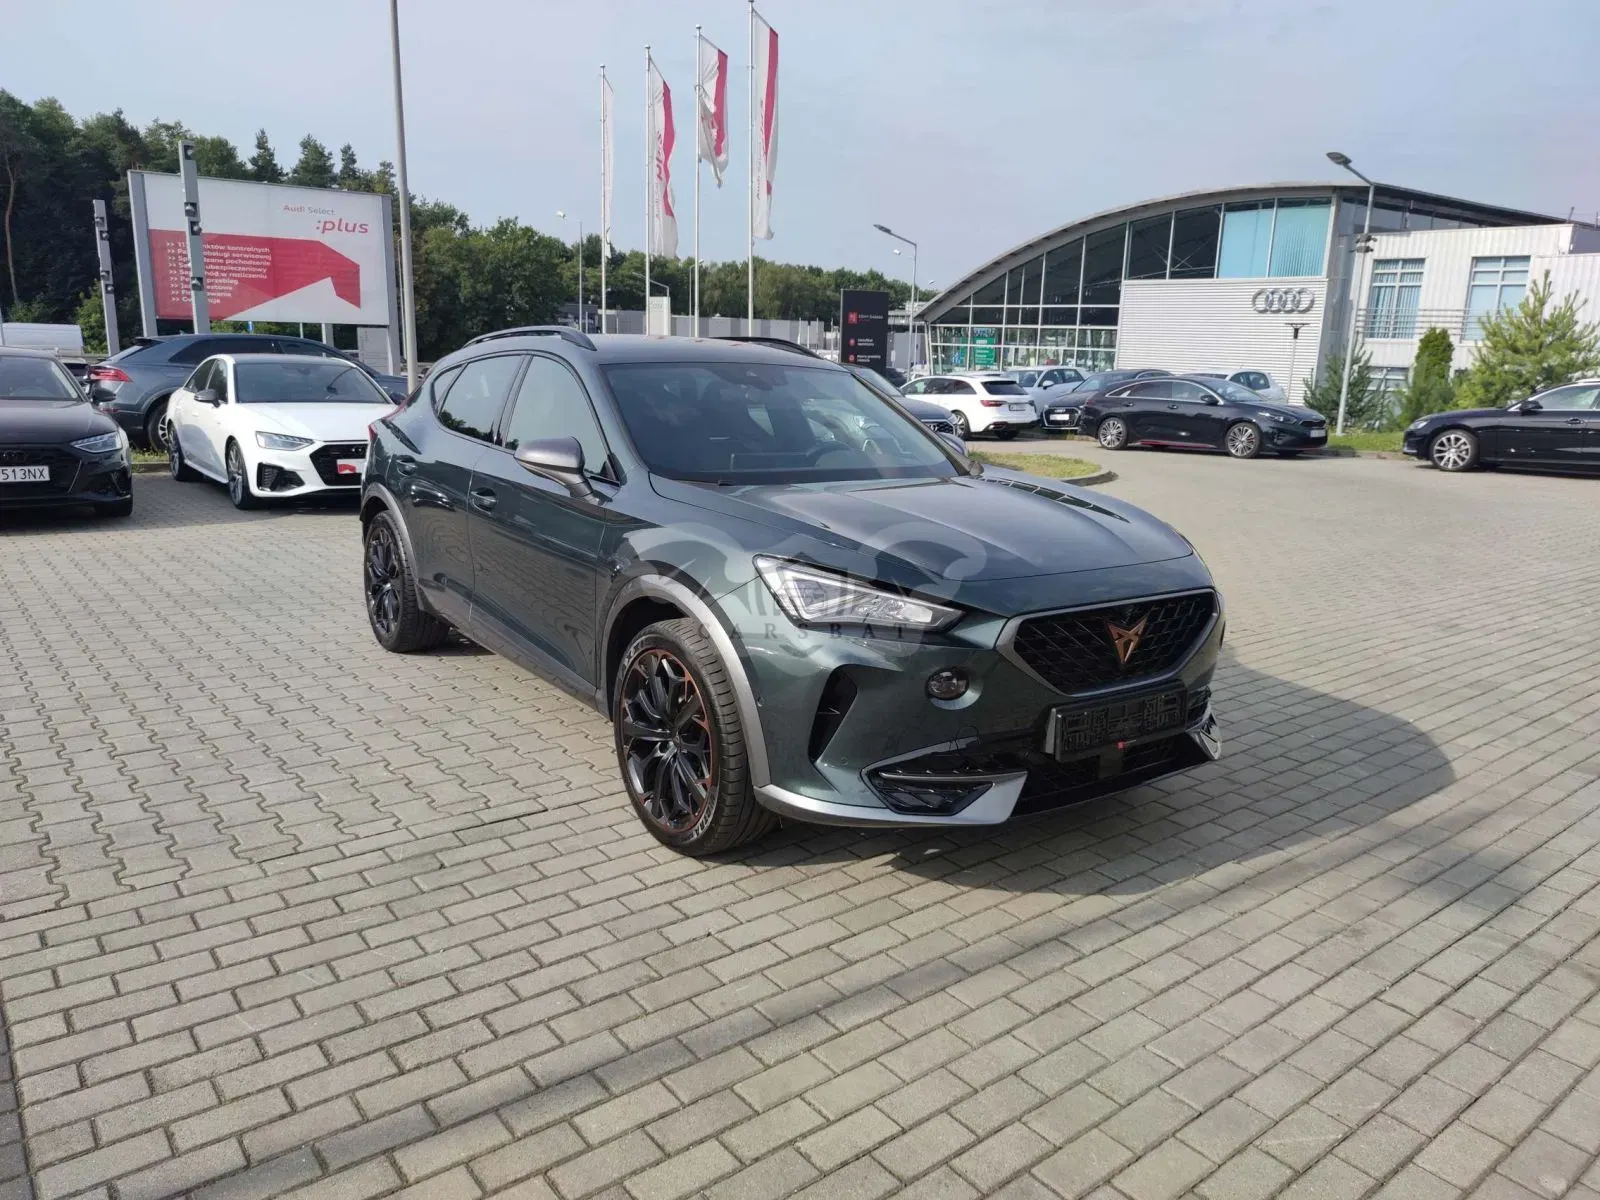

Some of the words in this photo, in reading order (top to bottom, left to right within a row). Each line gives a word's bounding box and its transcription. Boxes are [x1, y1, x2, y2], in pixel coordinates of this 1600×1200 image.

[308, 207, 335, 216] Select
[316, 218, 369, 234] :plus
[227, 245, 270, 253] kontrolnych
[1, 468, 45, 480] 513NX
